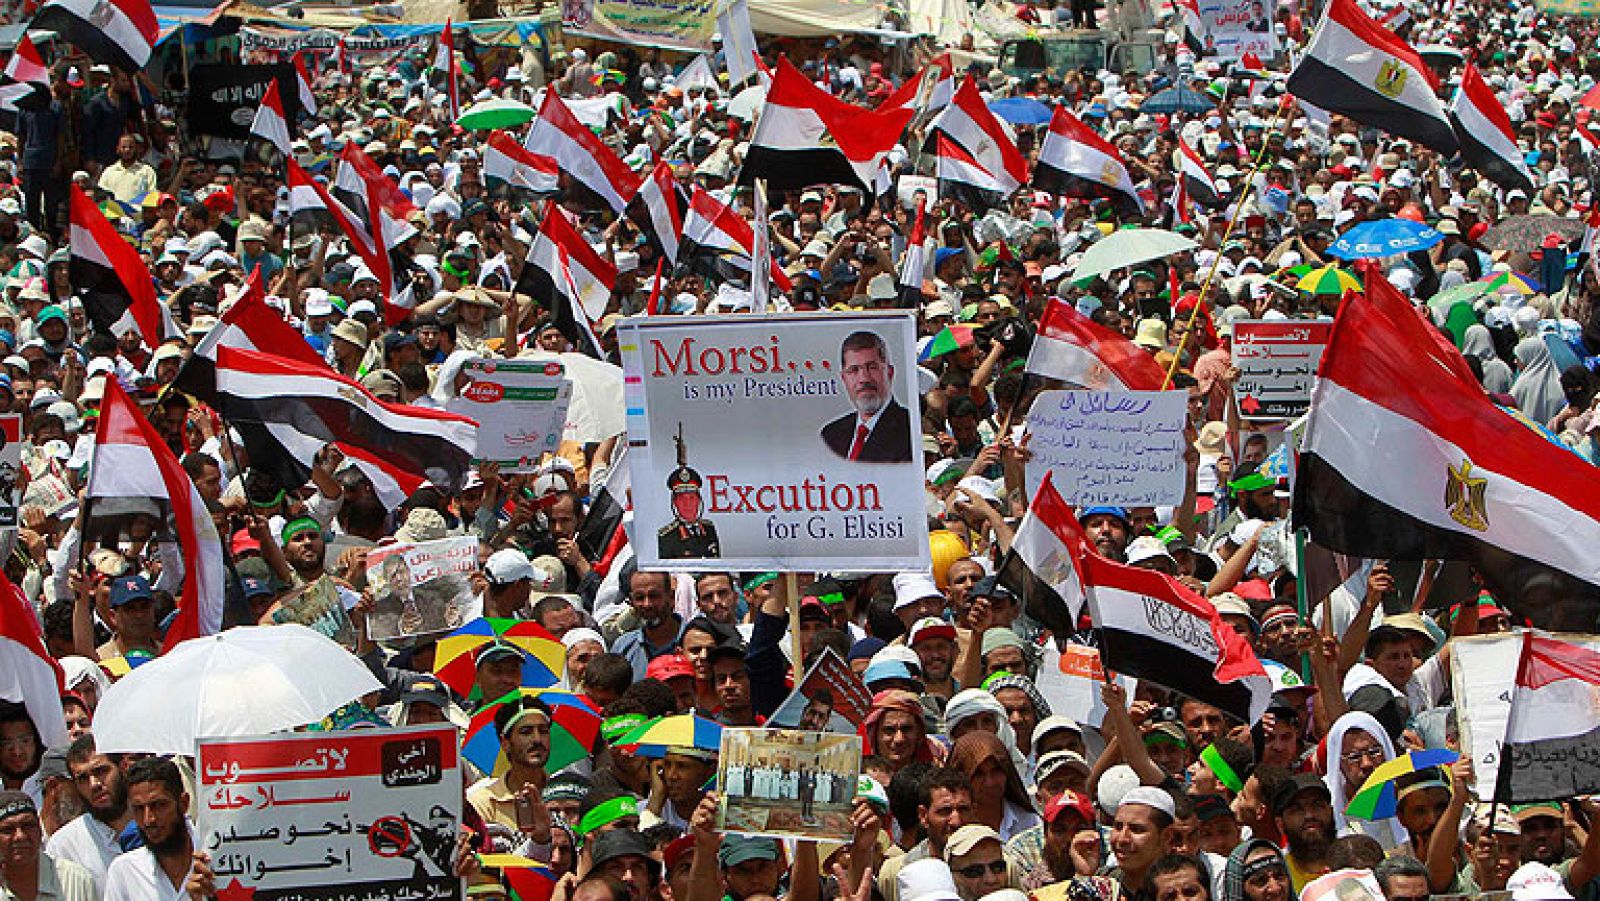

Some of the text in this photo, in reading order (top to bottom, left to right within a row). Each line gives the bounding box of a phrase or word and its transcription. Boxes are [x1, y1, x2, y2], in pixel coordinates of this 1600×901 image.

[650, 335, 832, 377] Morsi...
[684, 375, 838, 403] is my President
[705, 473, 884, 514] Excution
[766, 514, 905, 540] for G. Elsisi
[207, 784, 351, 810] سلاحك
[208, 813, 351, 850] نحو صدر
